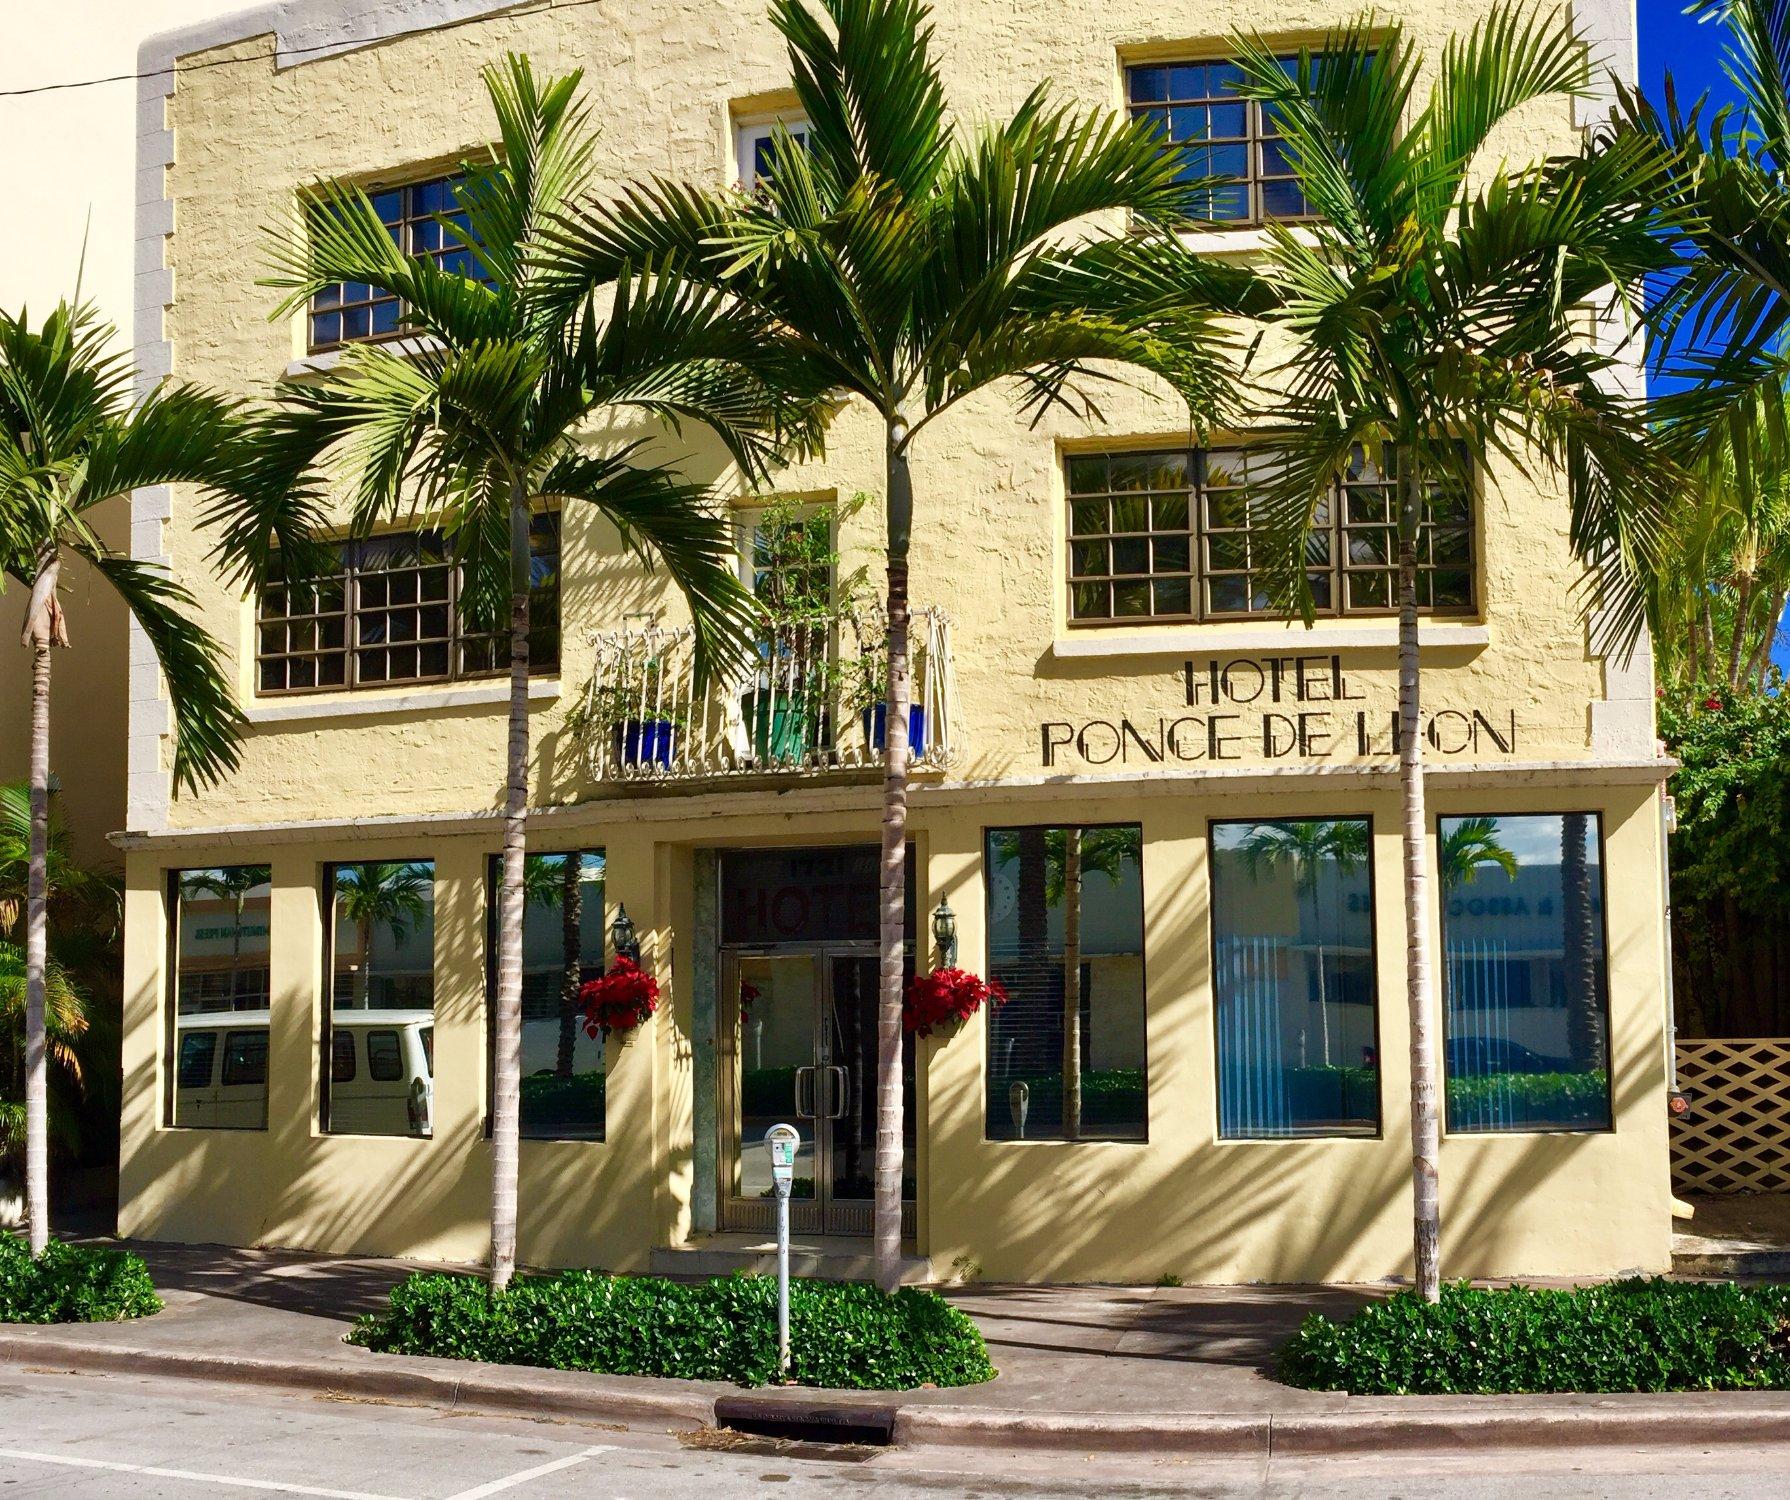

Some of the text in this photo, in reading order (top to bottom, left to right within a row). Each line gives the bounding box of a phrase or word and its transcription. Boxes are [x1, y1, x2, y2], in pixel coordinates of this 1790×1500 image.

[1184, 654, 1366, 706] HOTEL
[1041, 714, 1241, 767] PONCE
[1263, 711, 1332, 759] DE
